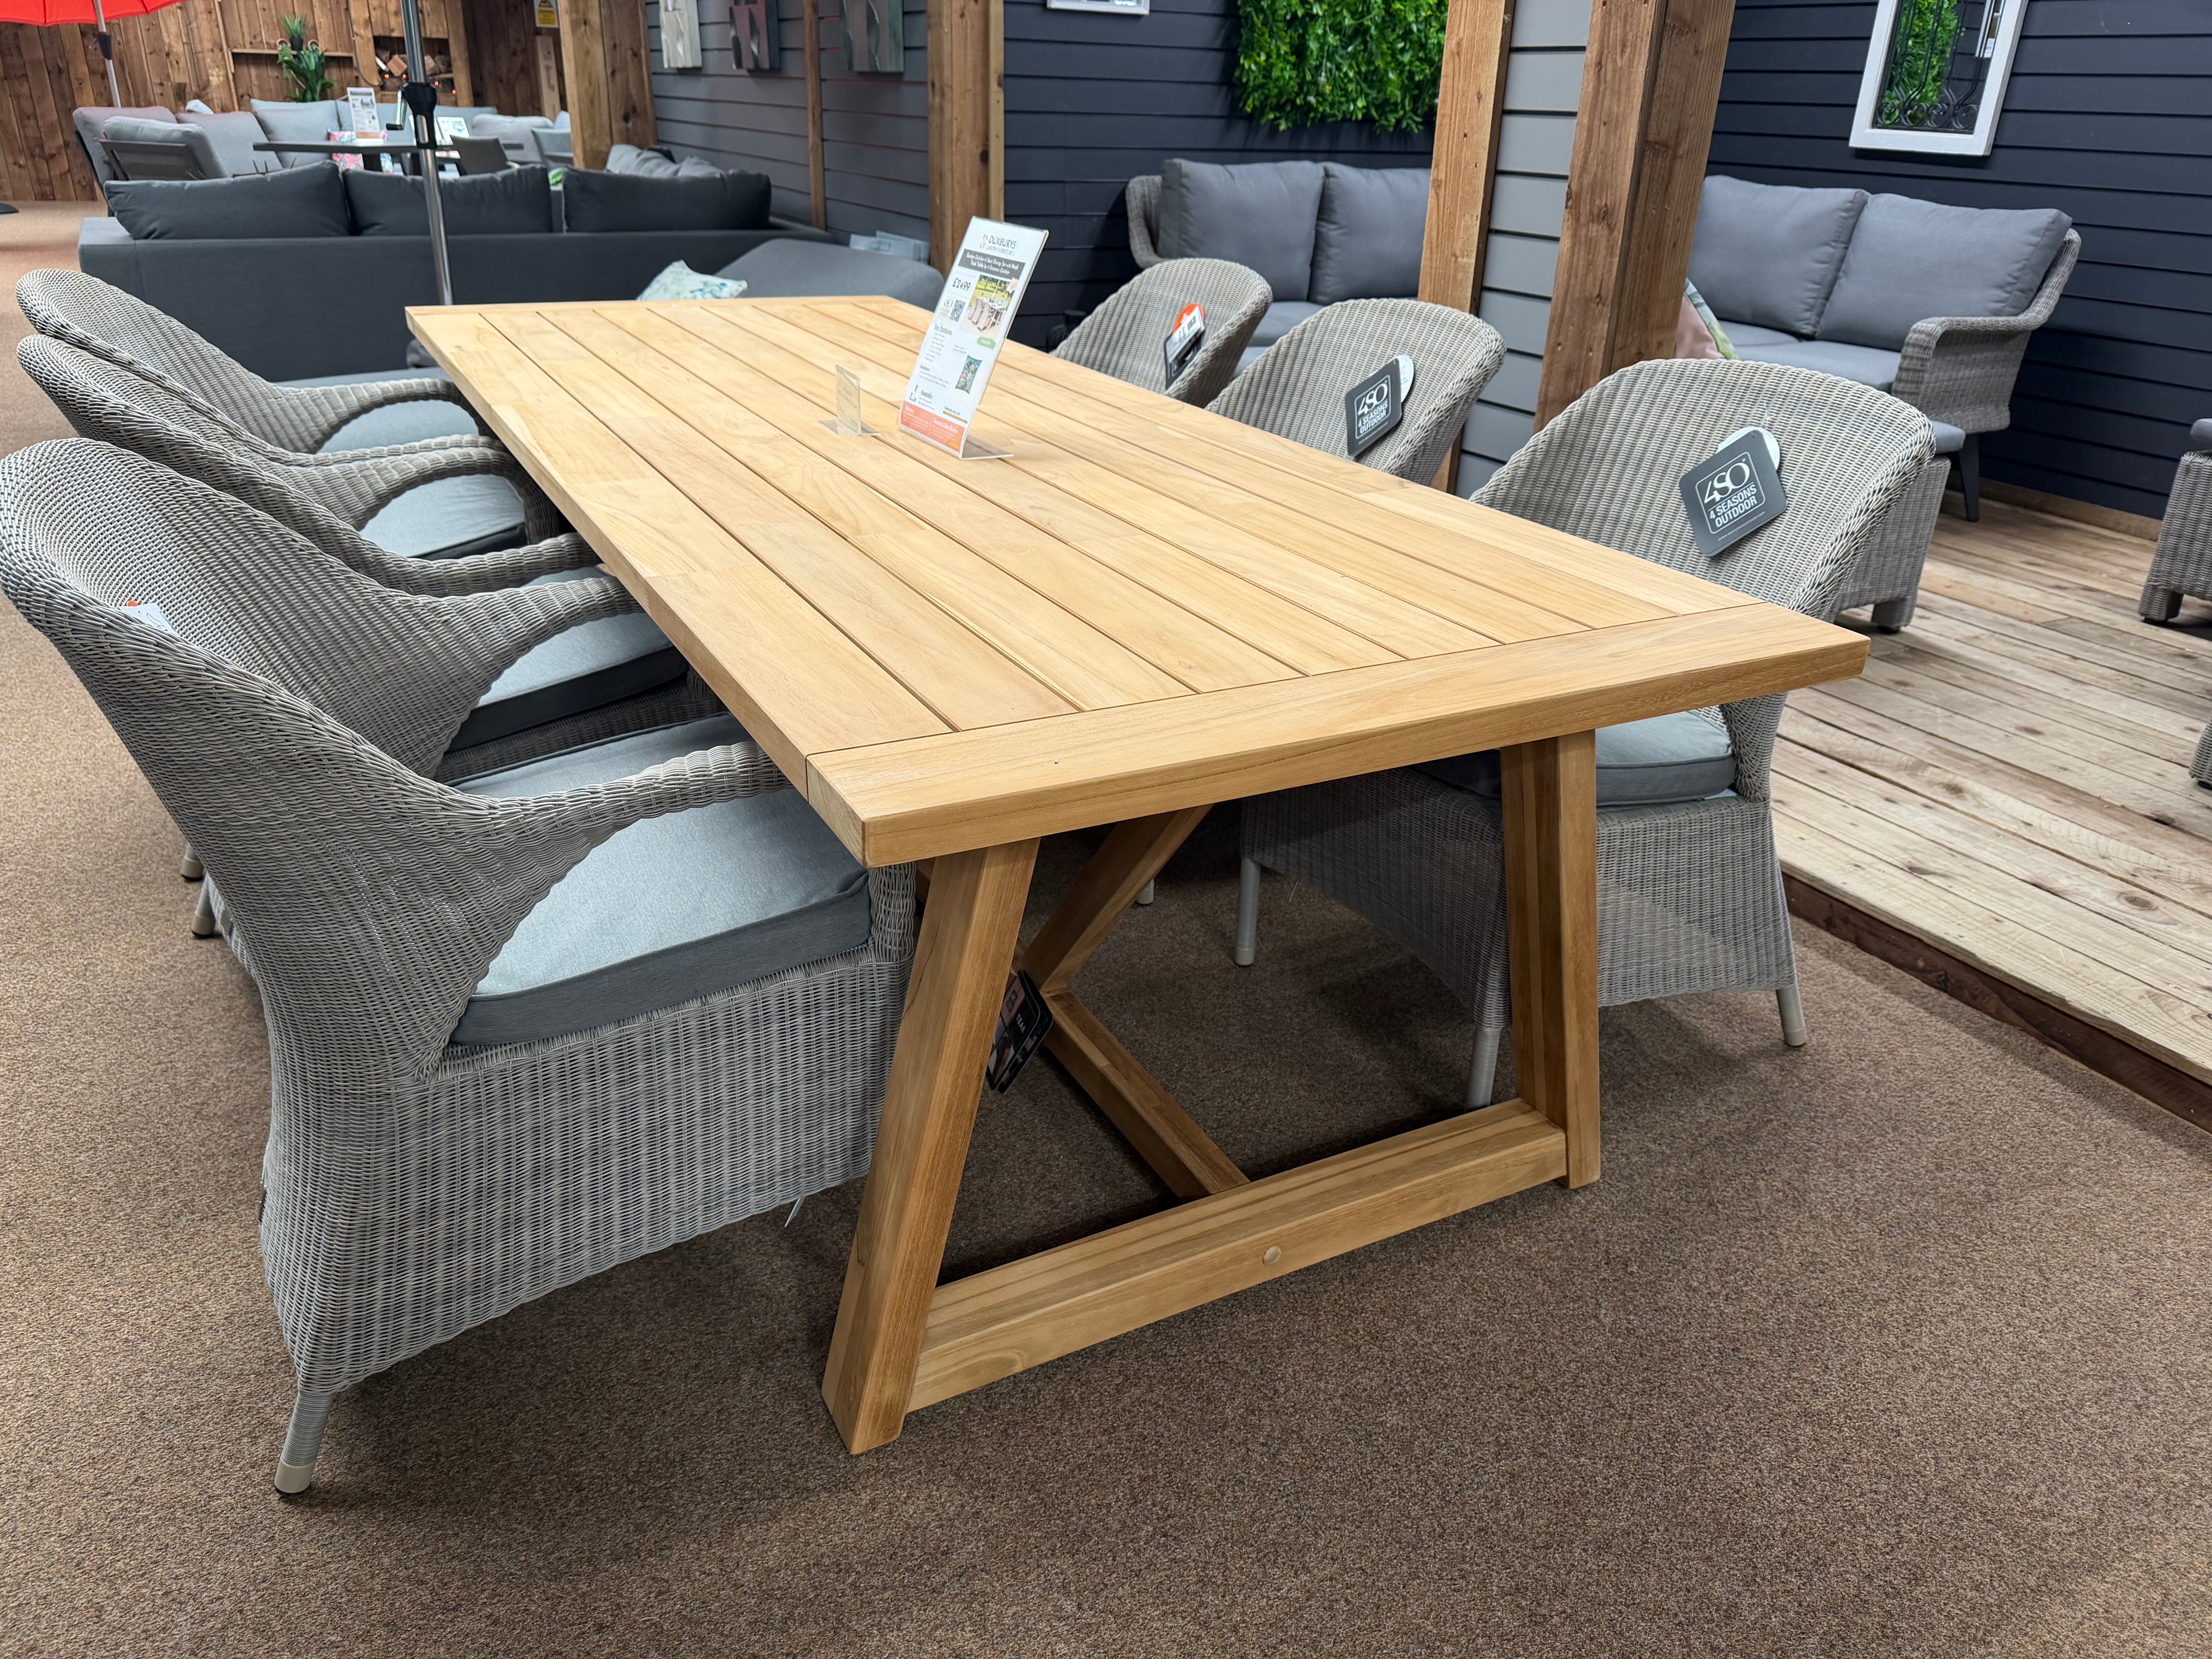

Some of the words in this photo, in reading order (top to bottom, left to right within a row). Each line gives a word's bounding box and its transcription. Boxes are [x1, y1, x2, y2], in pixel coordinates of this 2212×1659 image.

[988, 235, 1017, 249] DUXBURYS
[952, 278, 971, 291] £2499
[1360, 410, 1386, 434] OUTDOOR
[1363, 400, 1388, 425] SEASONS
[1704, 462, 1750, 504] 4SO
[1709, 510, 1716, 519] 4
[1716, 484, 1757, 515] SEASONS
[1715, 496, 1758, 527] OUTDOOR
[1016, 1013, 1026, 1034] TEAK
